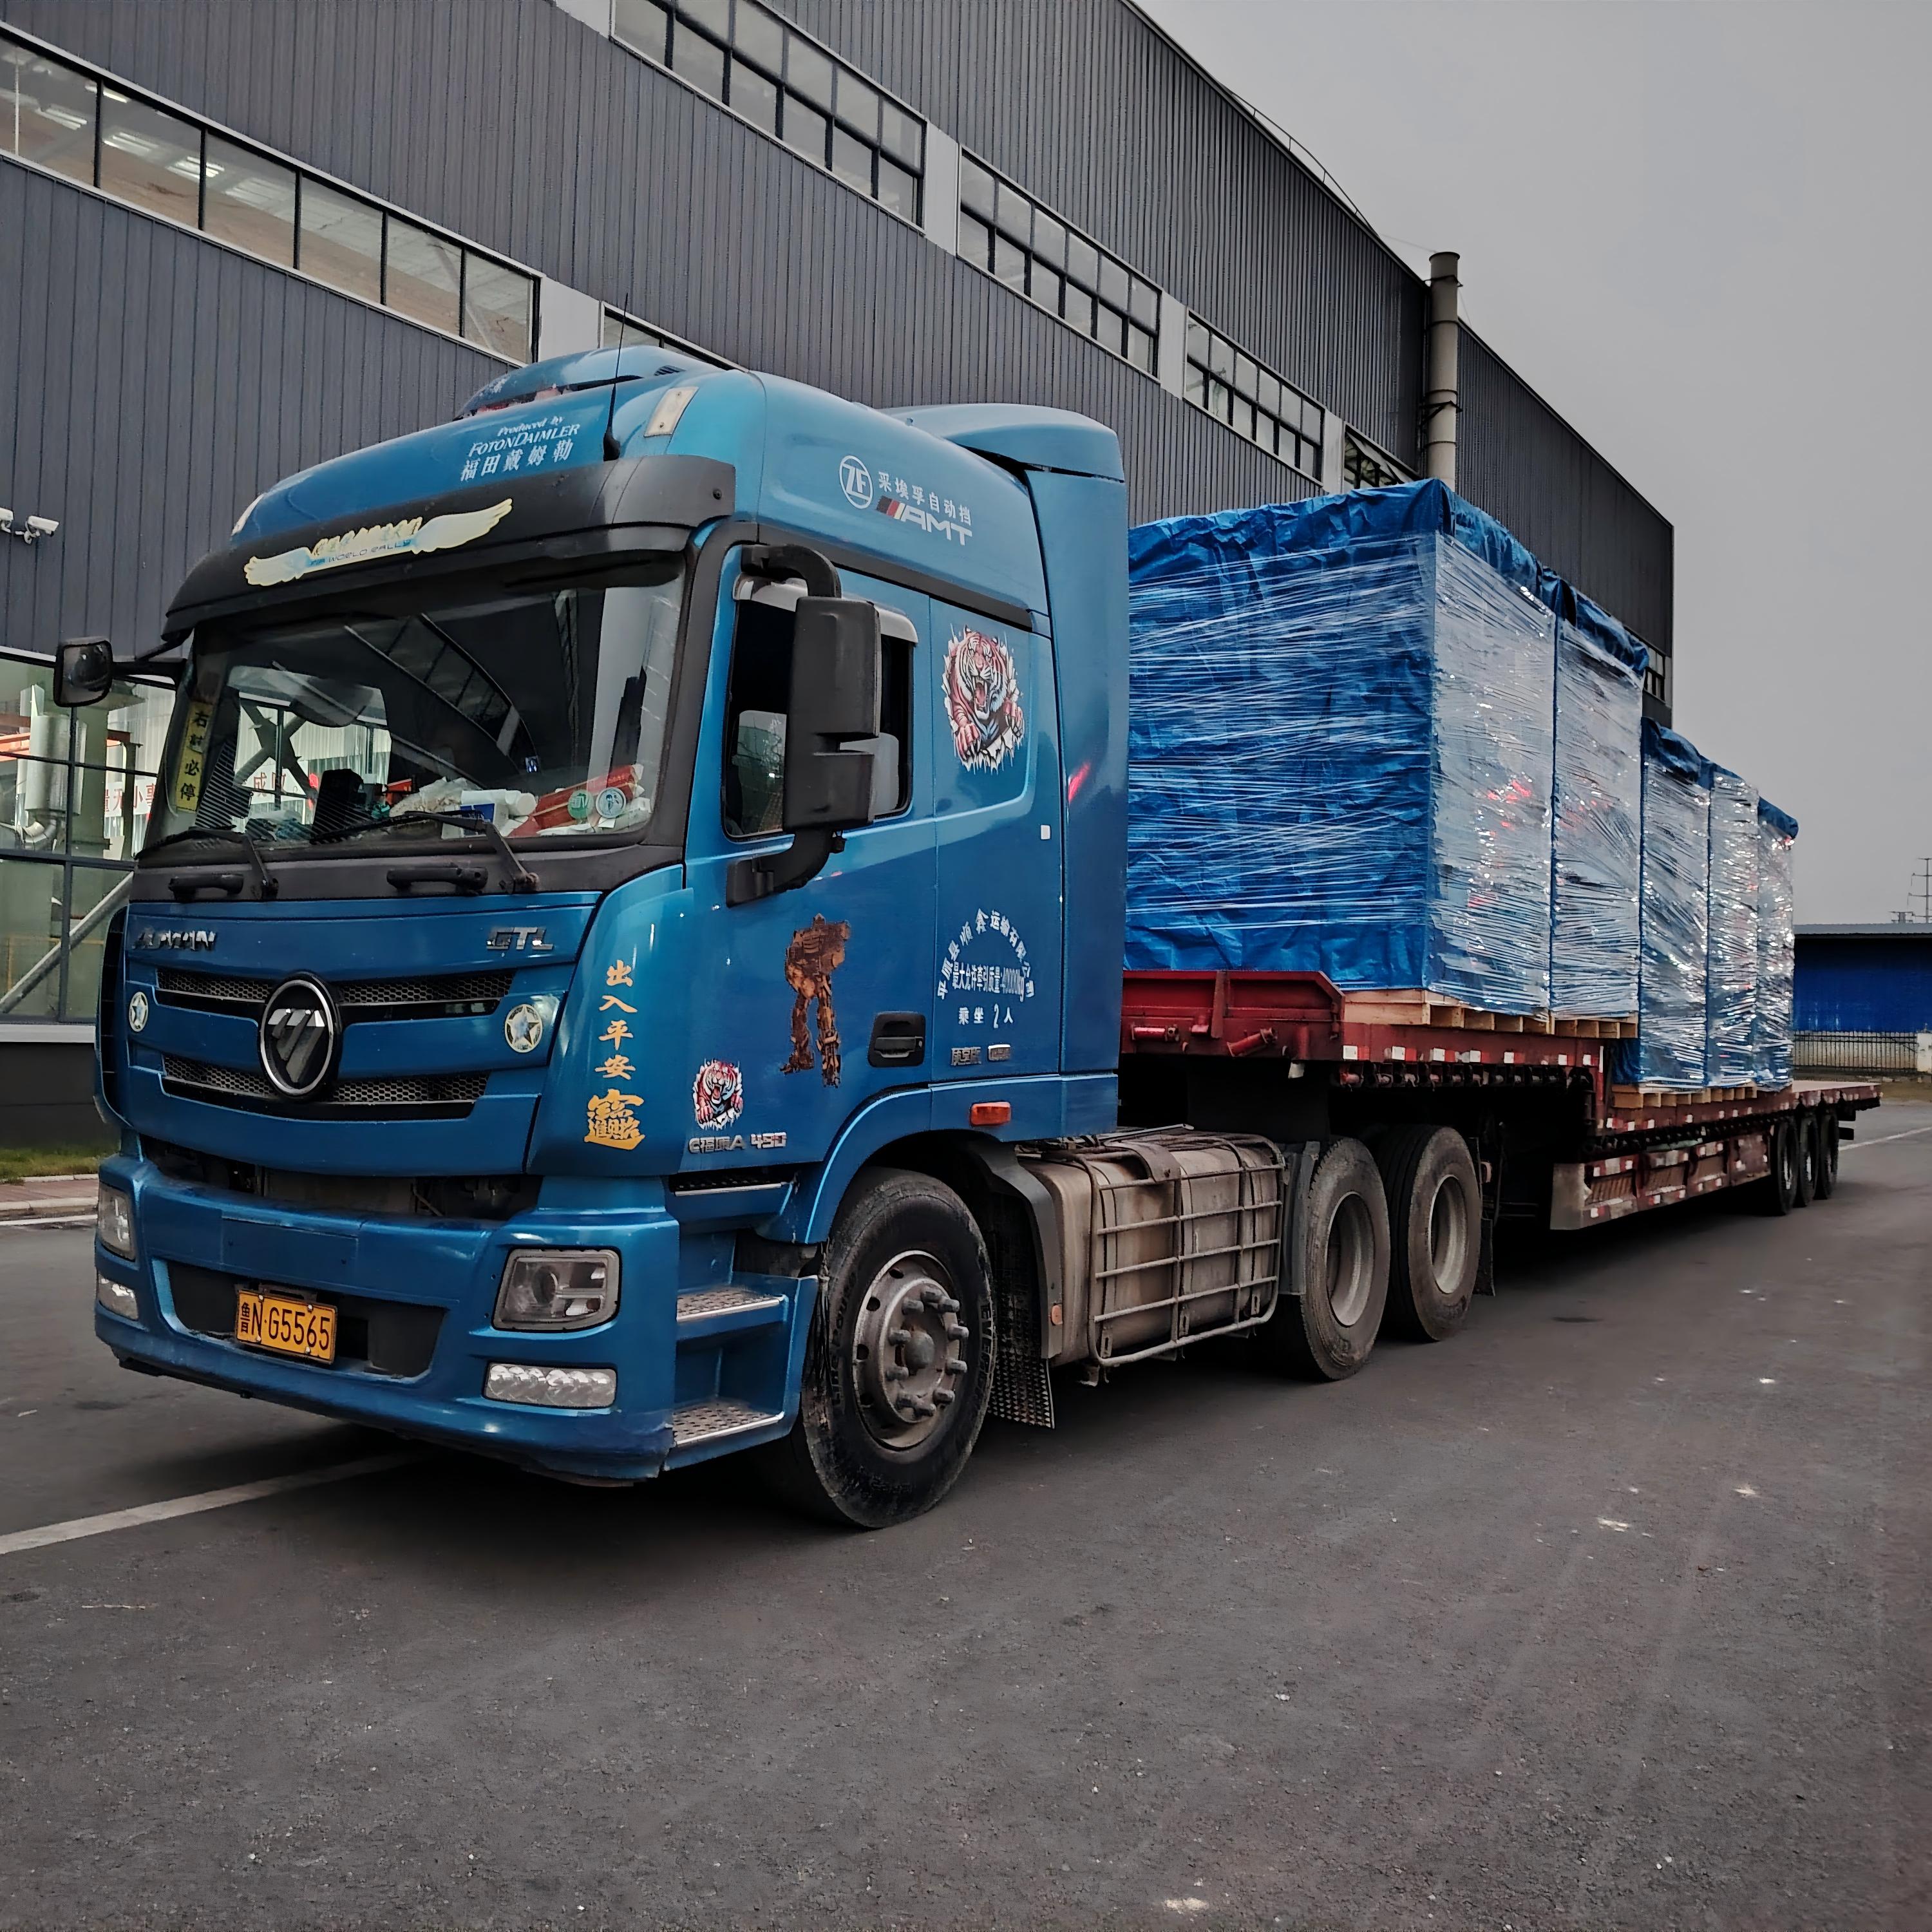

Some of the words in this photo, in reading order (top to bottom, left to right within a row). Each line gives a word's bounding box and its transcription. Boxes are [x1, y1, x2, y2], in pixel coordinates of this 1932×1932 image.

[497, 417, 547, 437] Produced
[460, 438, 574, 482] 福田戴姆勒
[840, 459, 872, 505] ZF
[486, 927, 554, 950] GTL
[595, 960, 638, 1080] 出入平安
[751, 1132, 787, 1150] 450
